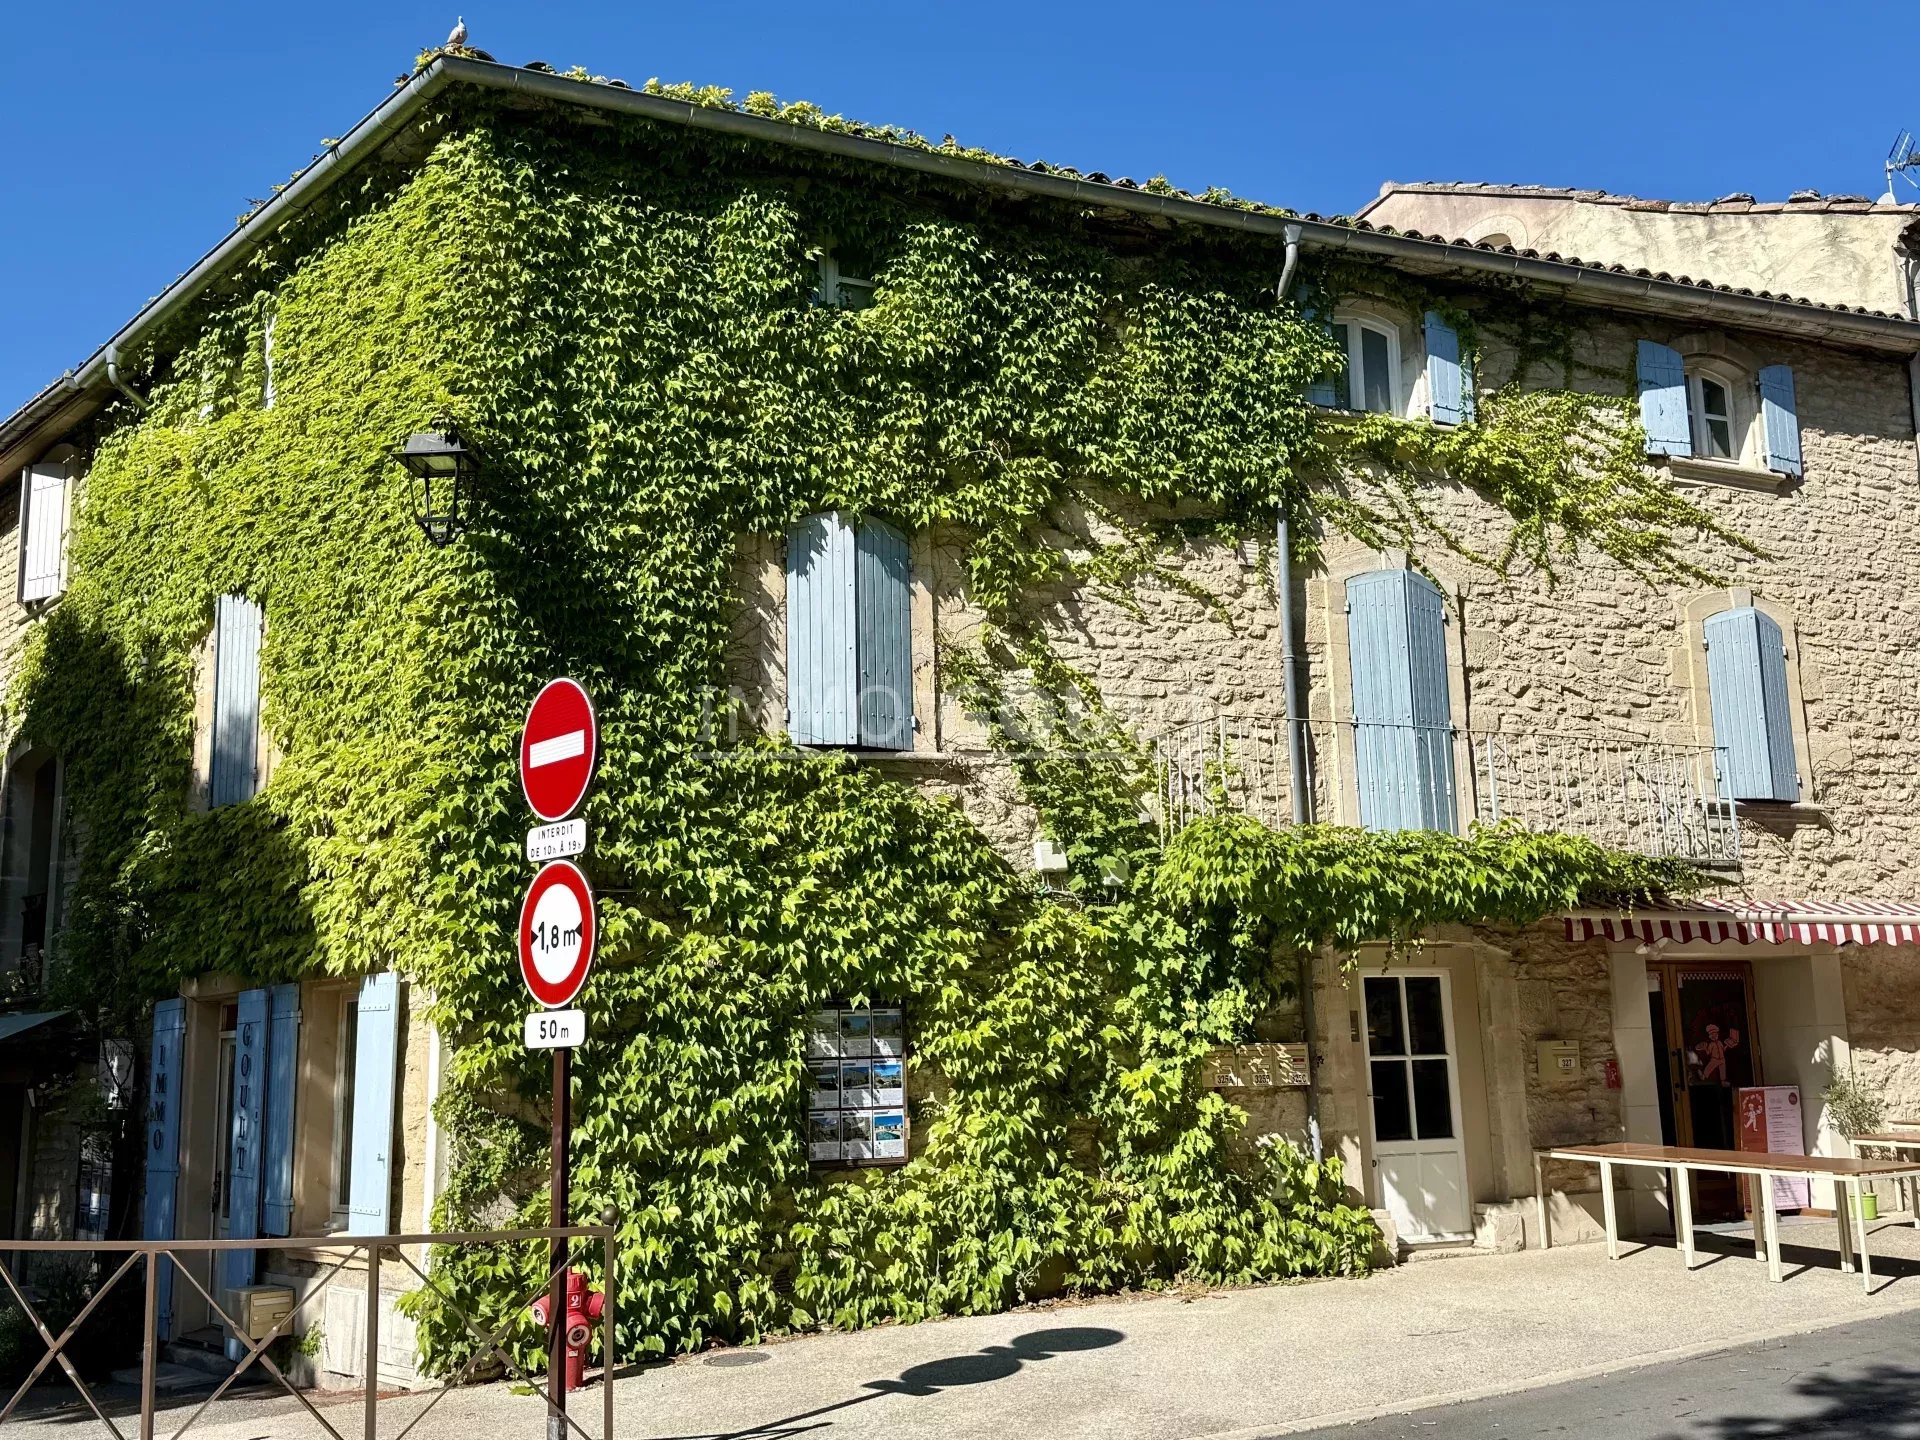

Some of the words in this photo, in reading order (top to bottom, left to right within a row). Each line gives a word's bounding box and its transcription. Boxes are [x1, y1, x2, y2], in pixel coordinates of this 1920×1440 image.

[531, 847, 540, 858] DE
[559, 840, 565, 853] À
[538, 824, 574, 840] INTERDIT
[153, 1045, 167, 1151] IMMO
[236, 1023, 253, 1171] GOULT
